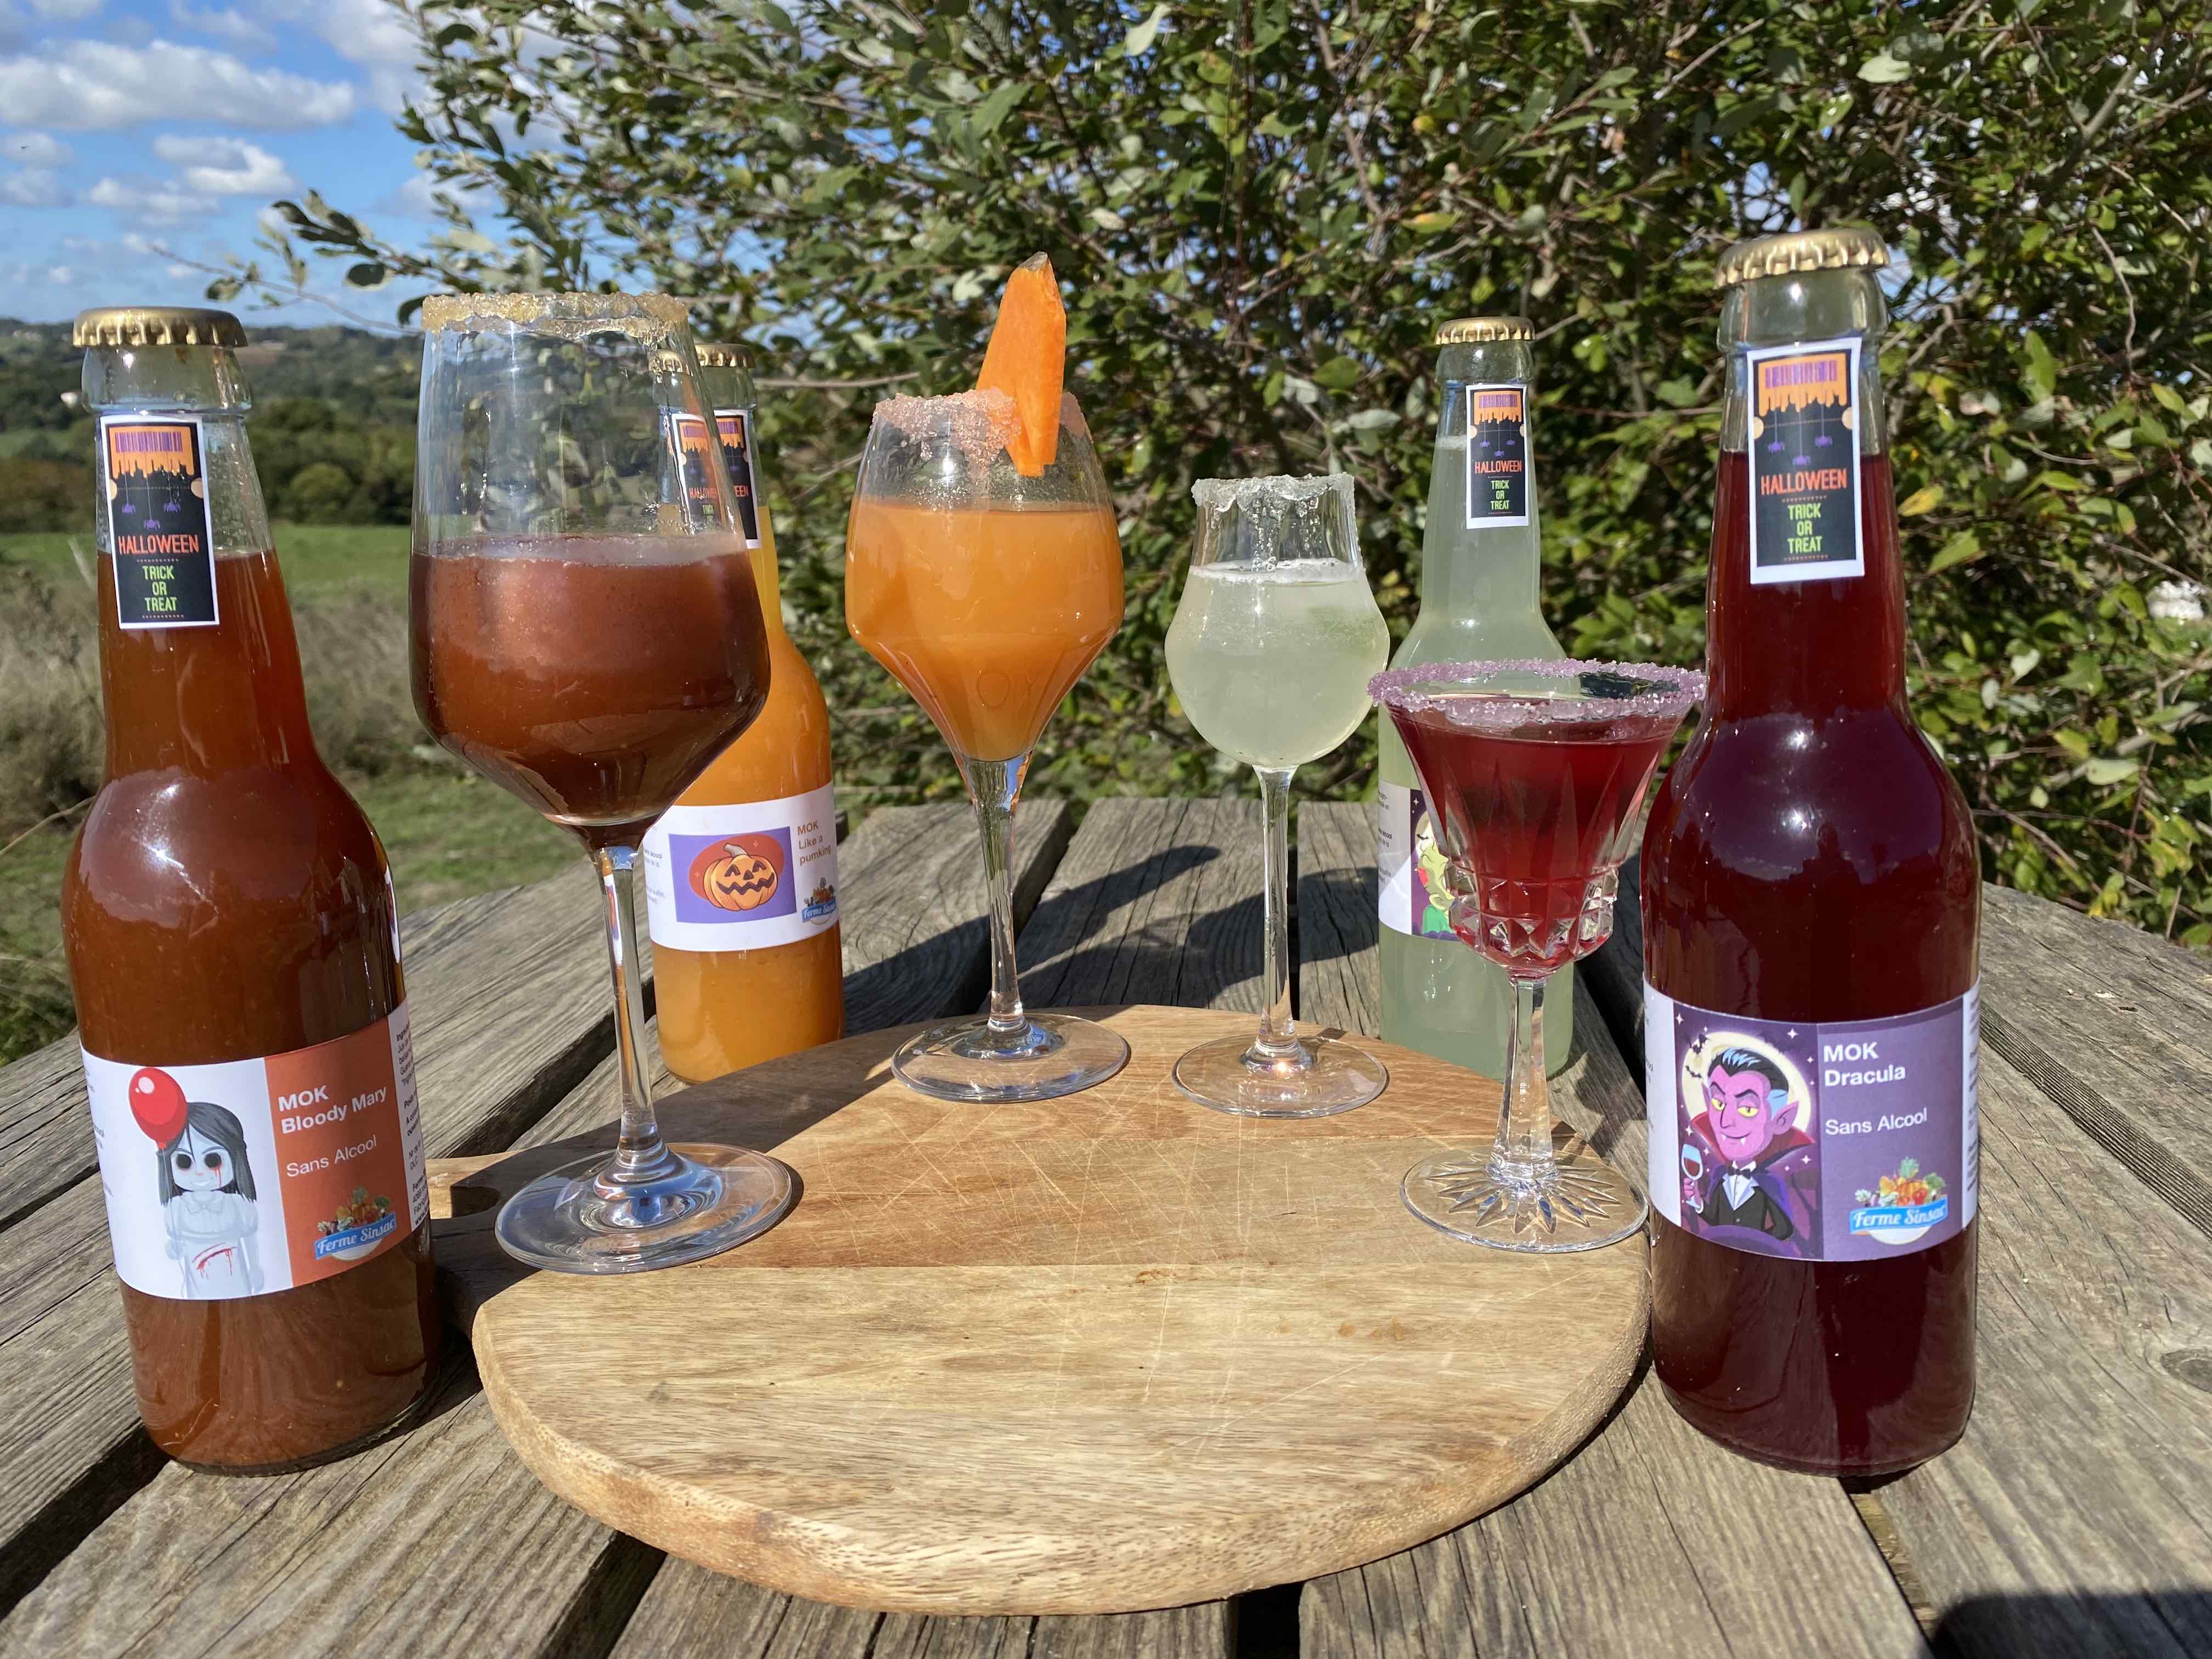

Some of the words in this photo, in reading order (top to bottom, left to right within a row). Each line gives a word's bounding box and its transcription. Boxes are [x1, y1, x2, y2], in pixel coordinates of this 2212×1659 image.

[1474, 460, 1522, 474] HALLOWEEN
[1491, 479, 1510, 490] TRICK
[1760, 467, 1848, 496] HALLOWEEN
[1496, 490, 1505, 500] OR
[1490, 500, 1510, 510] TREAT
[1787, 502, 1822, 521] TRICK
[1796, 520, 1813, 536] OR
[118, 534, 200, 555] HALLOWEEN
[1787, 535, 1822, 554] TREAT
[142, 565, 175, 580] TRICK
[152, 581, 167, 596] OR
[144, 596, 177, 612] TREAT
[797, 820, 819, 836] MOK
[799, 838, 817, 850] Like
[799, 845, 832, 867] pumking
[1823, 1041, 1879, 1063] MOK
[1824, 1063, 1906, 1087] Dracula
[278, 1085, 329, 1112] MOK
[281, 1104, 347, 1134] Bloody
[352, 1085, 386, 1113] Mary
[1825, 1119, 1872, 1136] Sans
[1877, 1106, 1927, 1132] Alcool
[286, 1156, 329, 1177] Sans
[334, 1133, 377, 1164] Alcool
[1853, 1211, 1901, 1228] Ferme
[317, 1234, 357, 1254] Ferme
[360, 1218, 396, 1242] Sinsac
